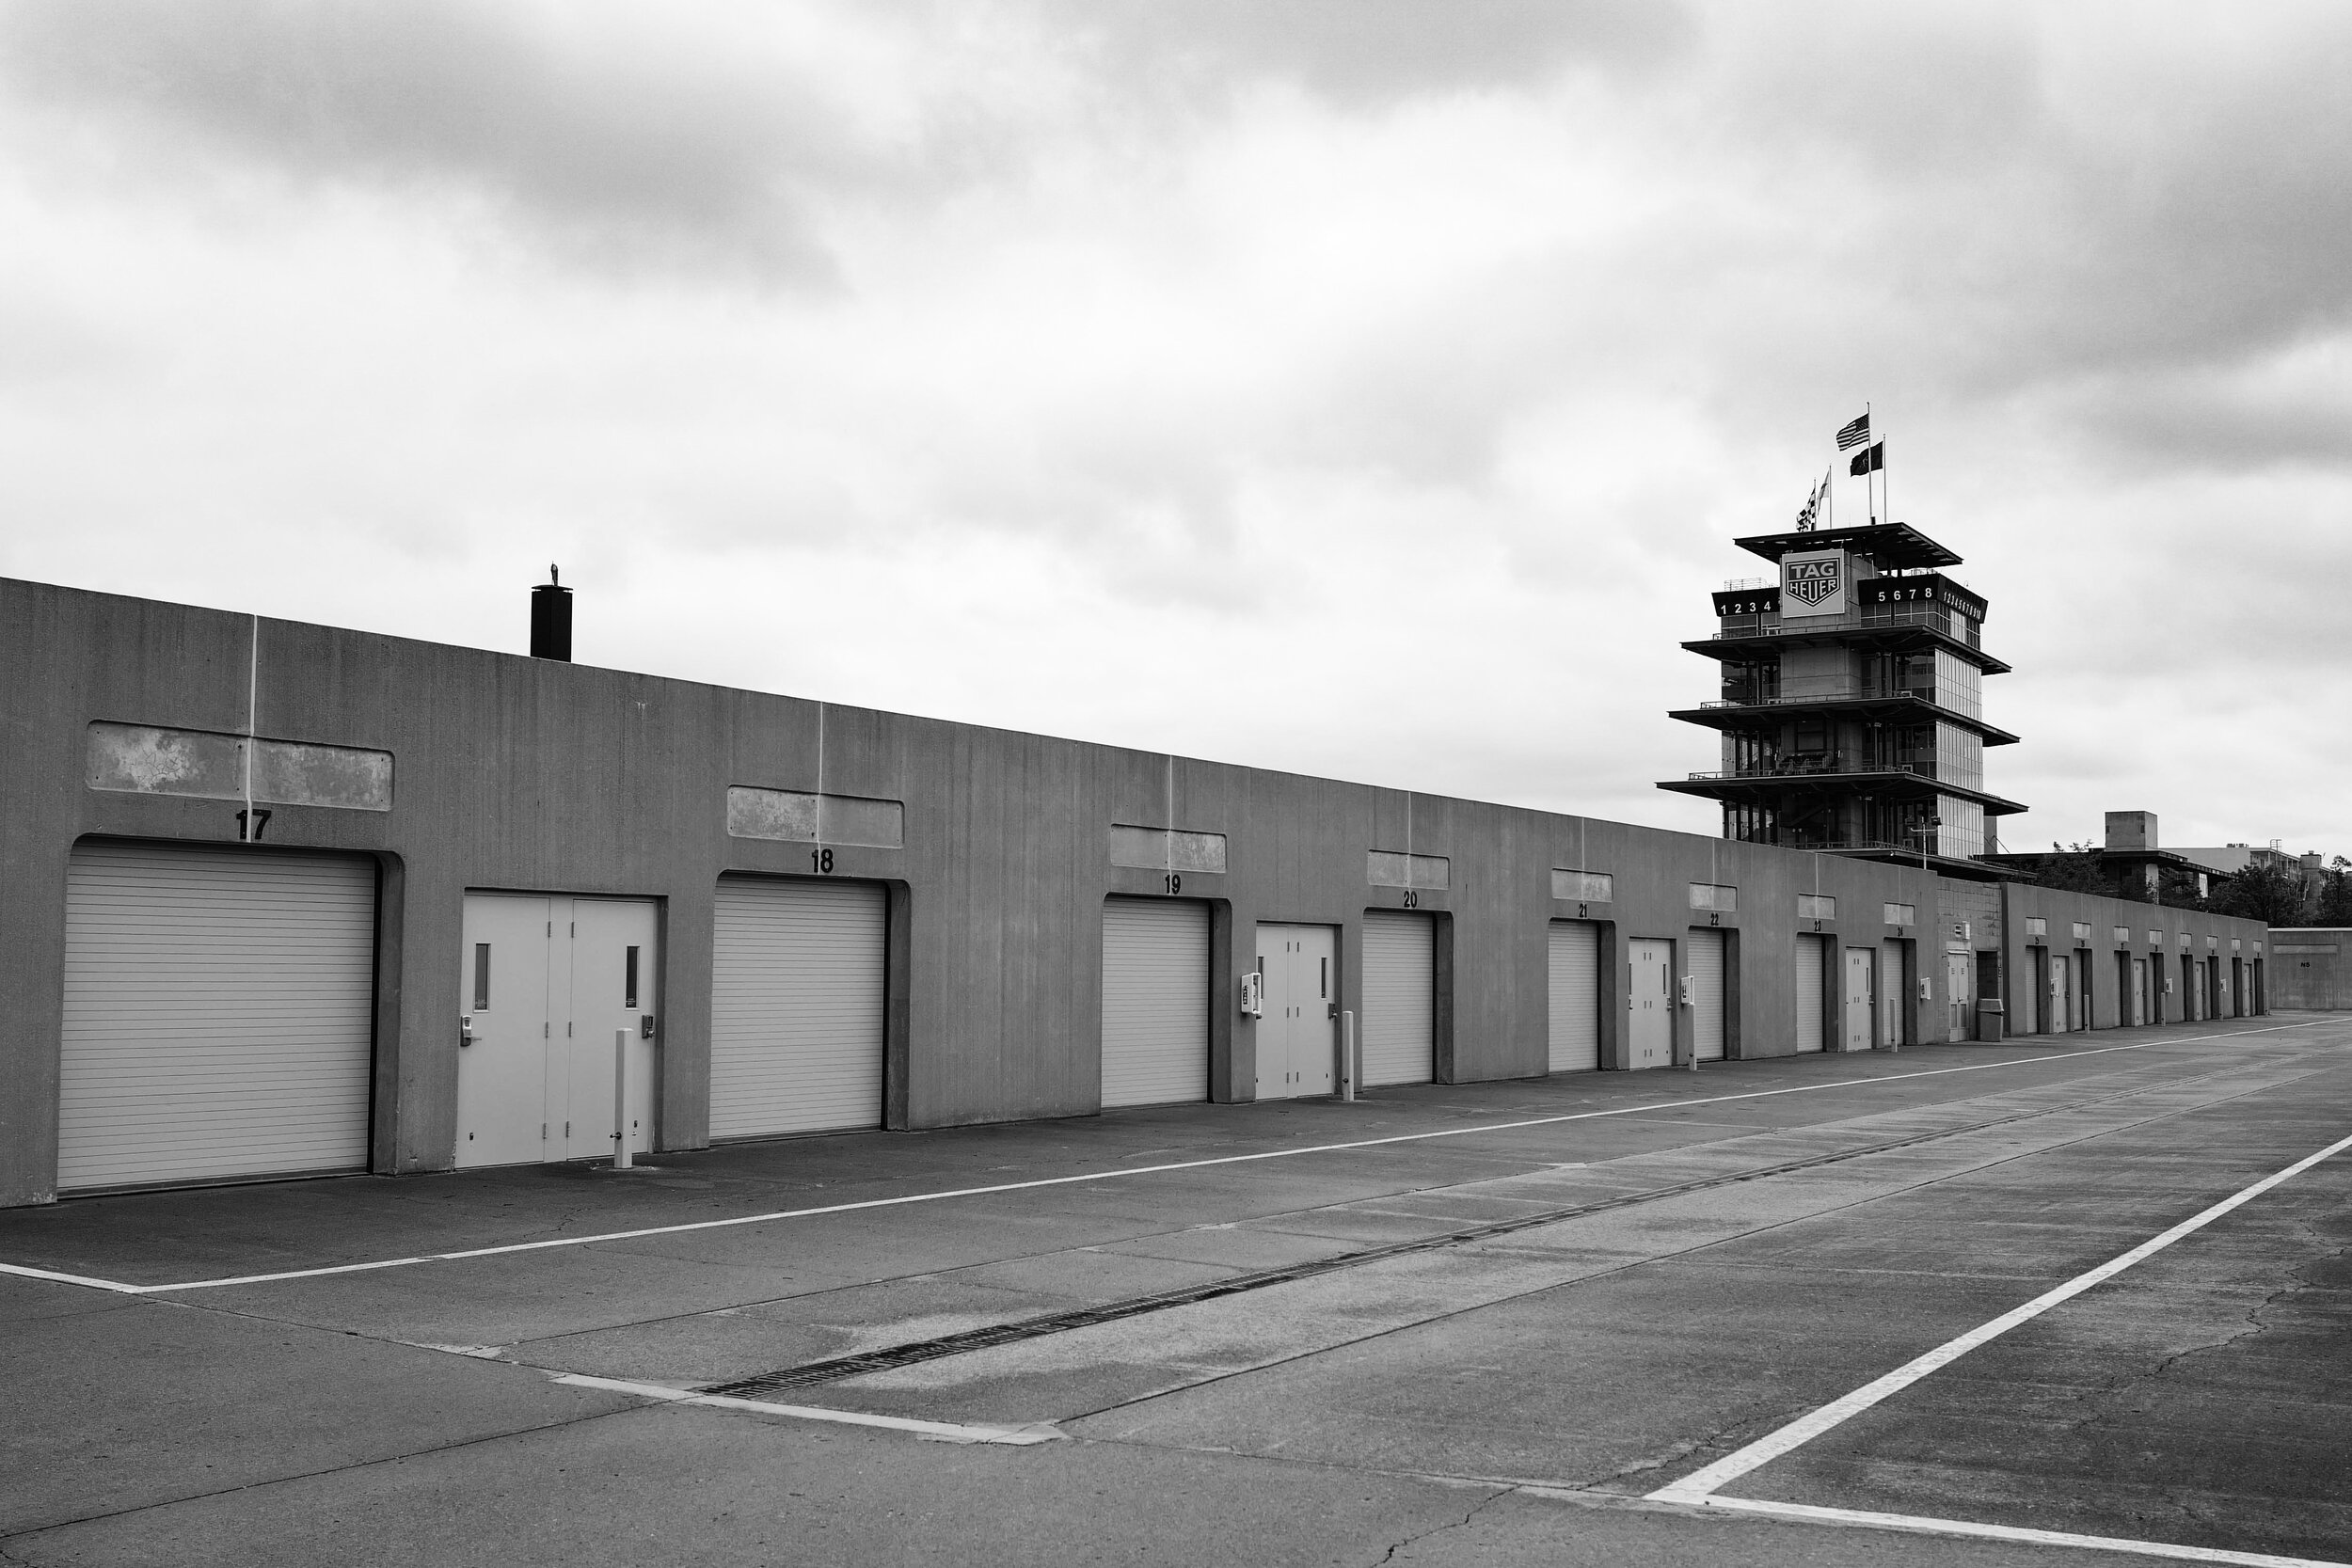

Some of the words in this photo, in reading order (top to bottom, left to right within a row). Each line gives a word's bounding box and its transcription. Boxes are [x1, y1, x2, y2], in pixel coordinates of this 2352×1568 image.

[1790, 562, 1835, 578] TAG
[1789, 579, 1836, 601] HEUER
[1878, 591, 1885, 602] 5
[1893, 590, 1900, 601] 6
[1909, 589, 1916, 600] 7
[1925, 587, 1932, 598] 8
[1721, 604, 1726, 615] 1
[1734, 603, 1741, 613] 2
[1749, 602, 1756, 612] 3
[1763, 600, 1771, 611] 4
[236, 809, 271, 840] 17
[812, 849, 834, 873] 18
[1166, 875, 1181, 894] 19
[1404, 891, 1418, 908] 20
[1579, 903, 1587, 917] 21
[1710, 913, 1719, 926] 22
[1814, 920, 1821, 932] 23
